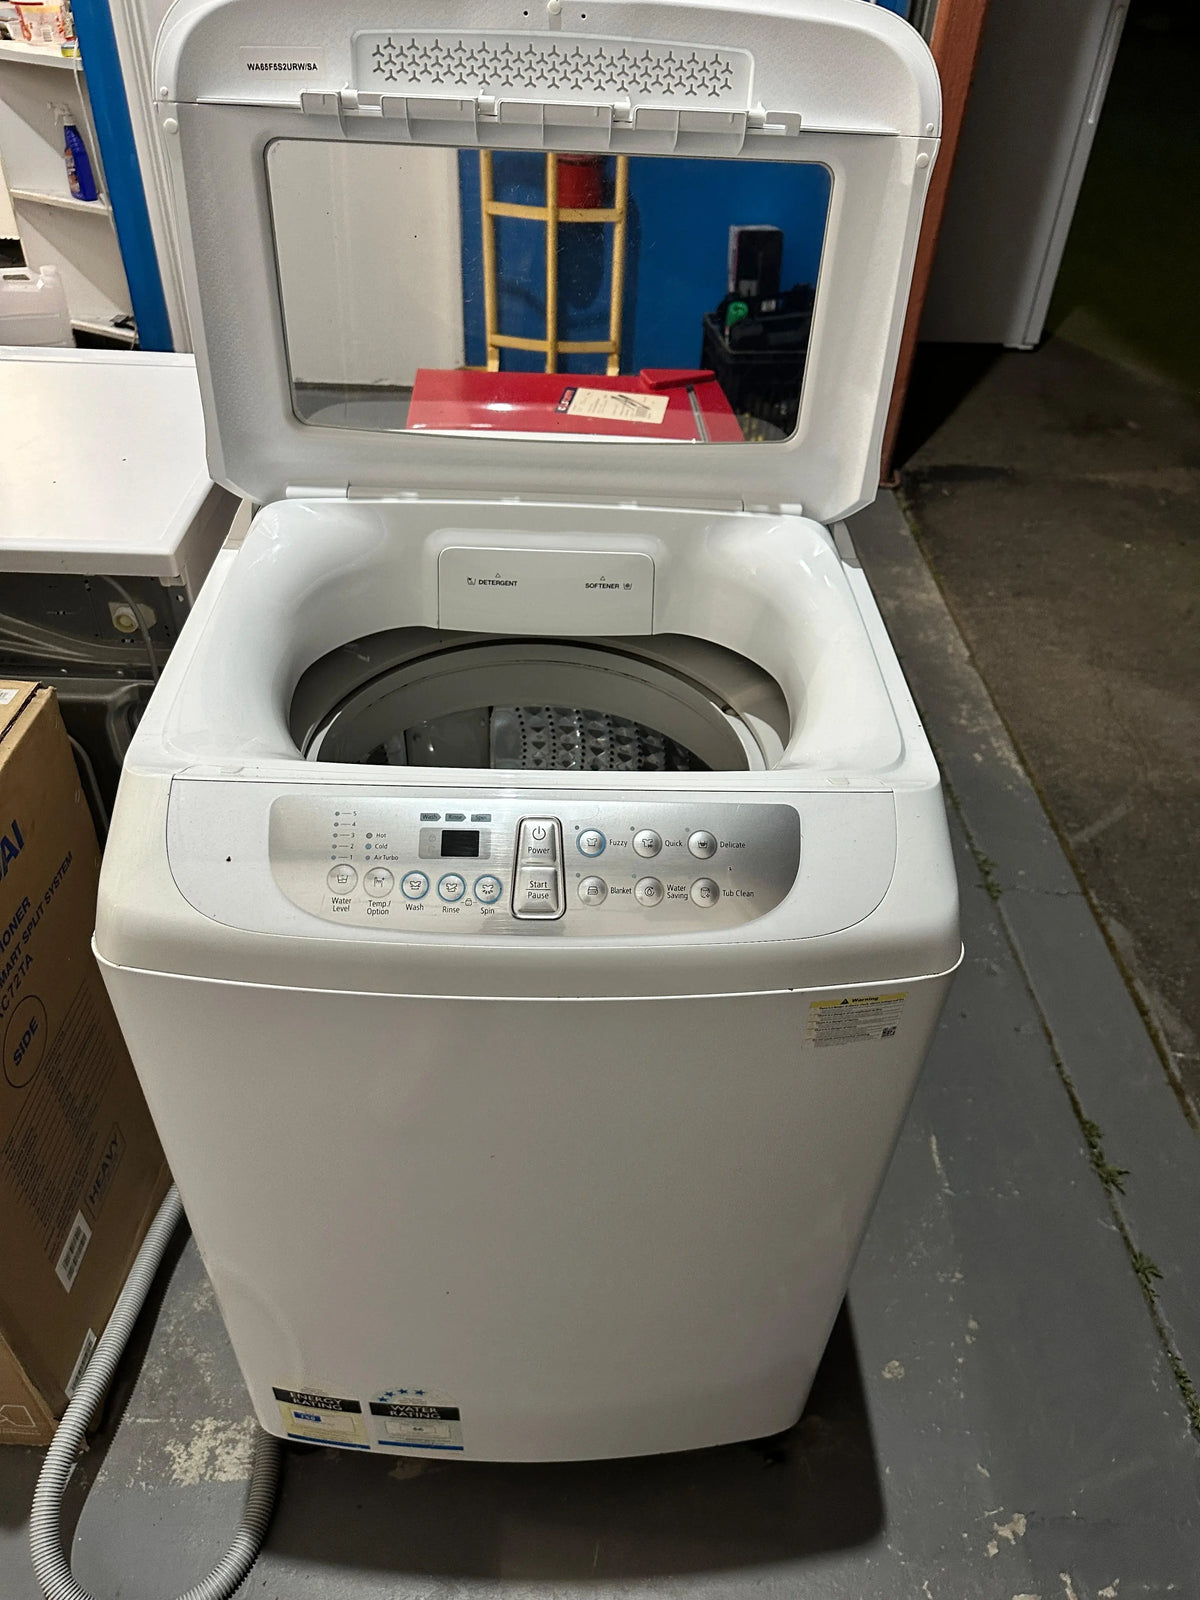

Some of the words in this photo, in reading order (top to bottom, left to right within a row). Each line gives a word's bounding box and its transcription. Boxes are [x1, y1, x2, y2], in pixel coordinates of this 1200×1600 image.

[478, 579, 518, 587] DETERGENT
[585, 582, 620, 590] SOFTENER
[609, 839, 628, 847] Fuzzy
[720, 841, 746, 849] Delicate
[0, 819, 24, 880] AI
[527, 846, 550, 855] Power
[529, 880, 548, 888] Start
[666, 884, 687, 892] Water
[610, 886, 632, 894] Blanket
[723, 889, 734, 897] Tub
[736, 889, 755, 897] Clean
[22, 902, 45, 944] SPLIT
[44, 849, 73, 905] SYSTEM
[331, 896, 352, 904] Water
[527, 892, 550, 900] Pause
[666, 892, 689, 900] Saving
[405, 903, 424, 911] Wash
[442, 905, 460, 913] Rinse
[480, 907, 495, 915] Spin
[366, 908, 390, 916] Option
[13, 1016, 39, 1066] SIDE
[89, 1130, 118, 1205] HEAVY
[289, 1392, 342, 1404] ENERGY
[293, 1398, 343, 1410] RATING
[390, 1405, 437, 1413] WATER
[390, 1410, 441, 1419] RATING
